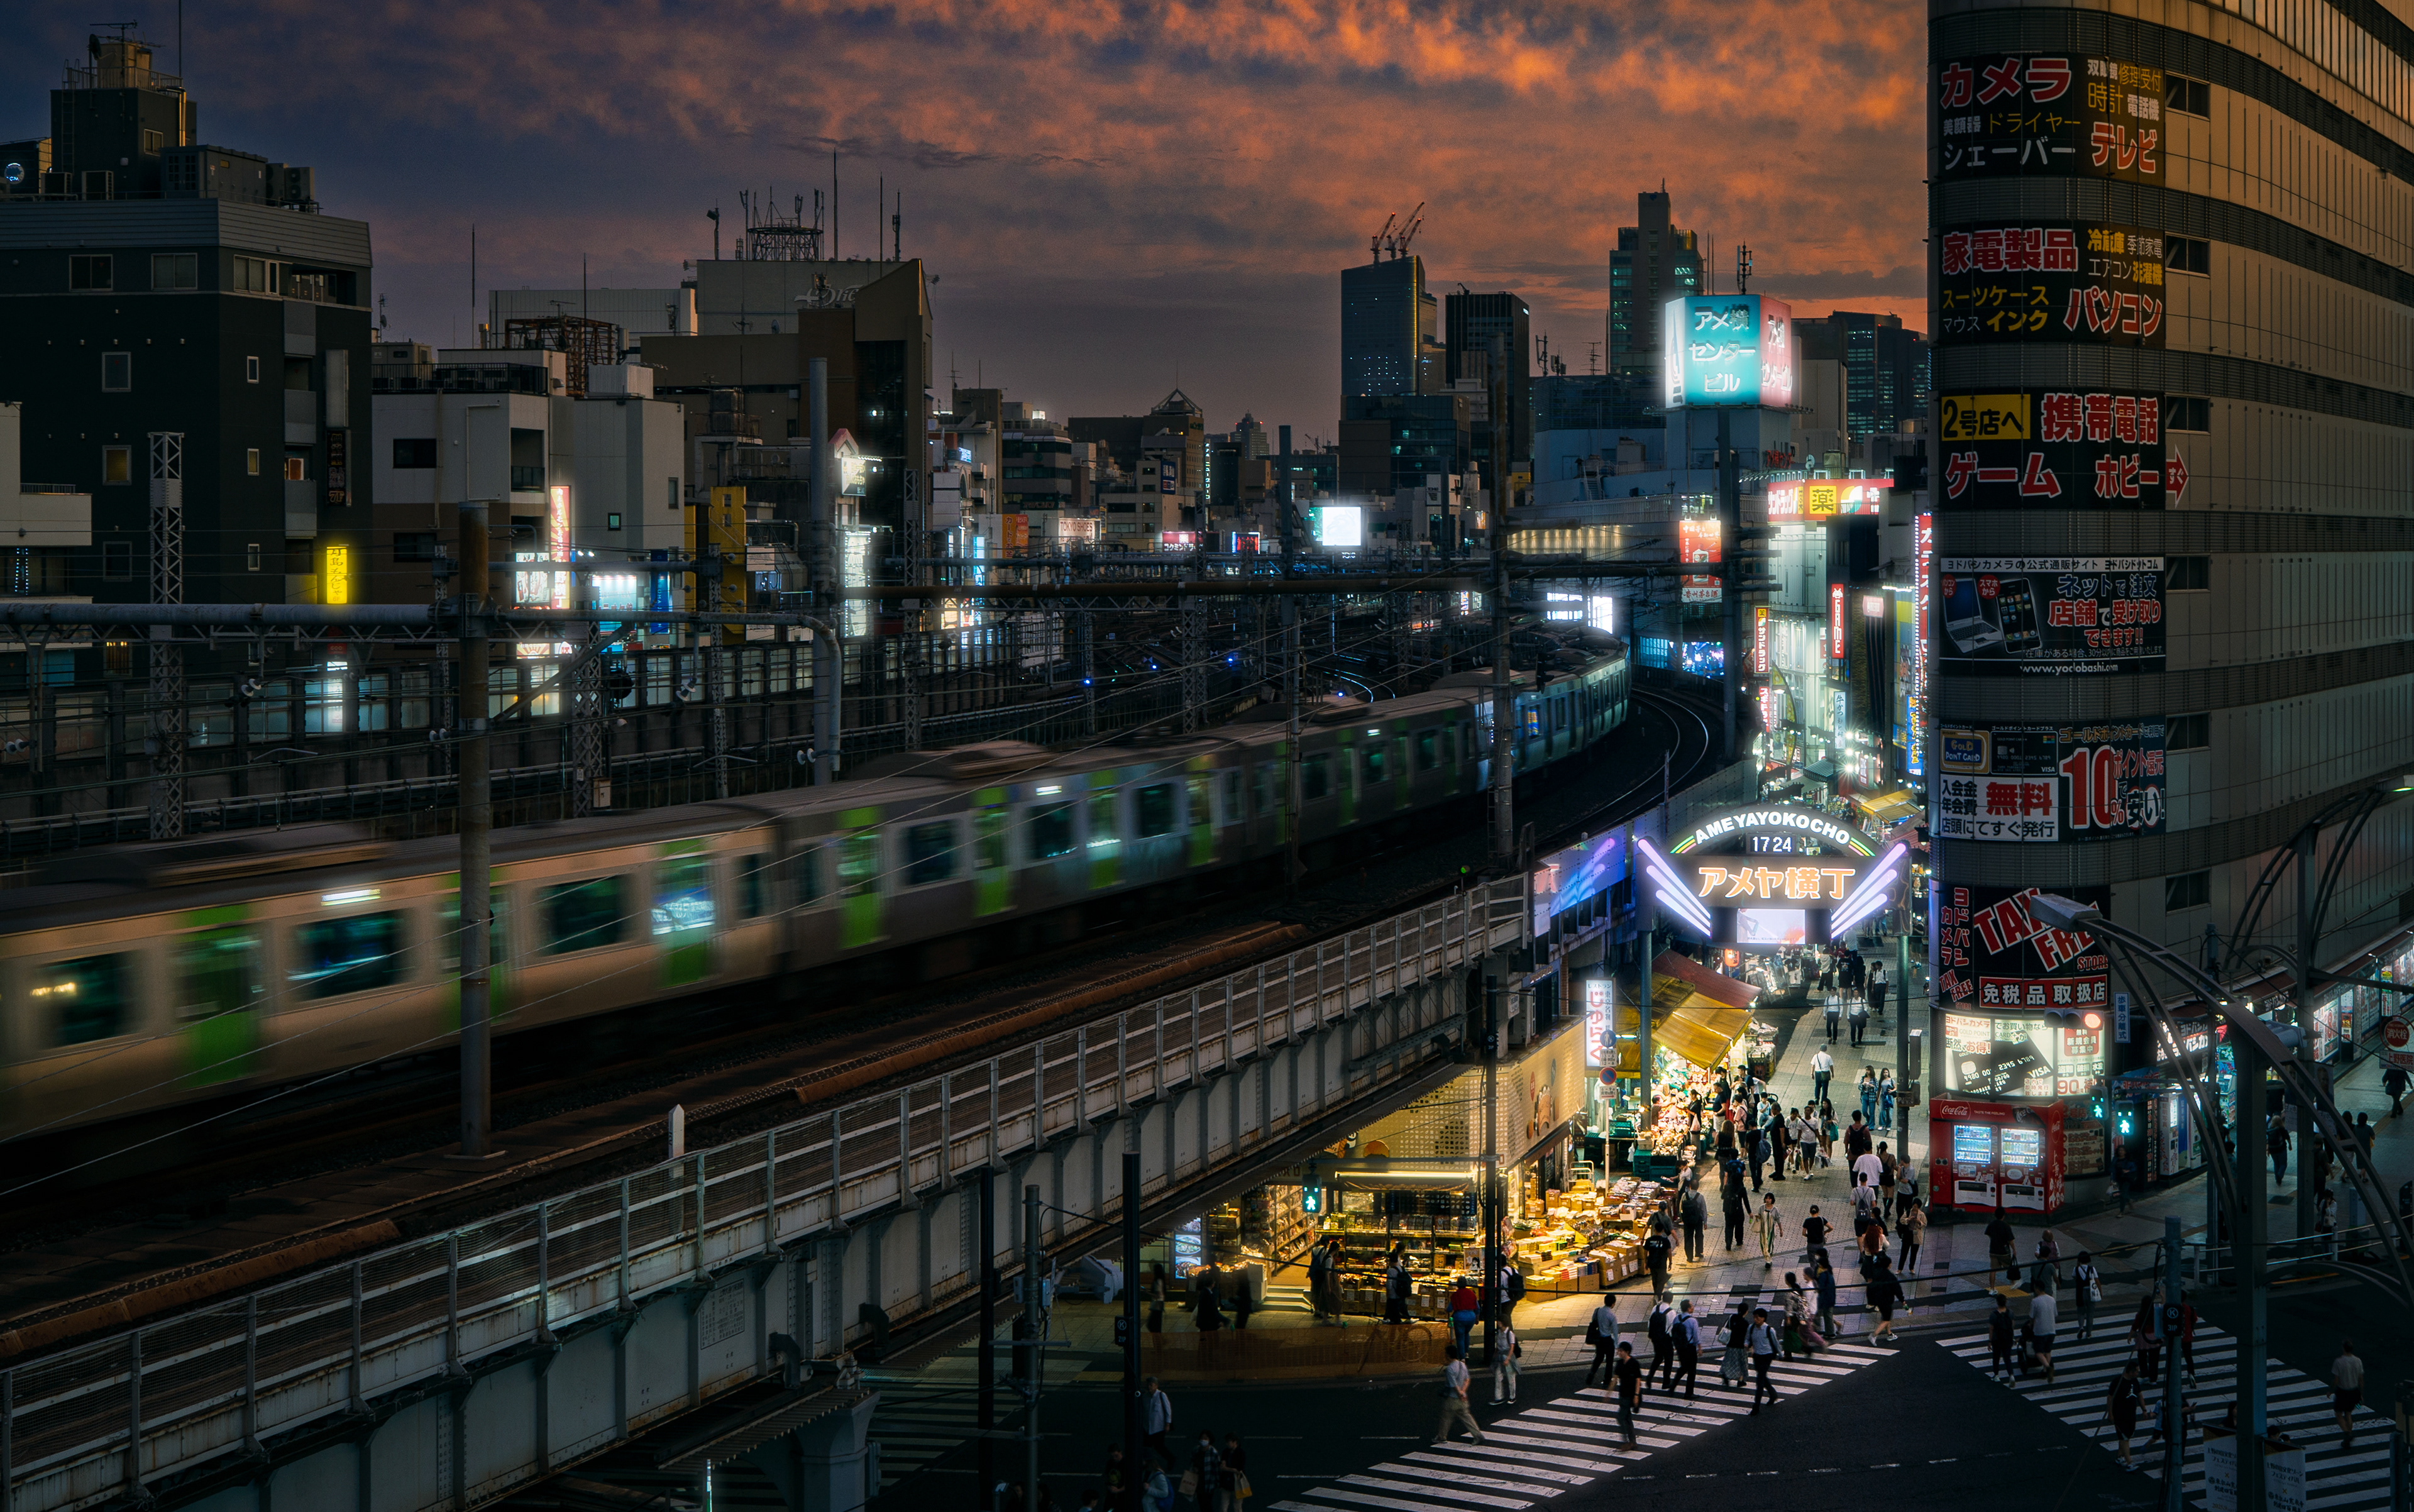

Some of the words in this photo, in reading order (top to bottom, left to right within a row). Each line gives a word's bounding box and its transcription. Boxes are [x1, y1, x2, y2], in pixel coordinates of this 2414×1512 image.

[1941, 58, 2071, 109] カメラ
[2119, 63, 2161, 92] 修理受付
[2088, 82, 2124, 114] 時計
[2127, 94, 2159, 121] 電話機
[1943, 116, 1981, 136] 美顔器
[1990, 112, 2080, 135] ドライヤー
[1944, 135, 2075, 170] シェーバー
[2091, 121, 2157, 174] テレビ
[1943, 227, 2078, 275] 家電製品
[2087, 228, 2124, 254] 冷蔵庫
[2127, 235, 2163, 258] 季節家電
[2088, 258, 2132, 279] エアコン
[2132, 260, 2163, 285] 洗濯機
[1943, 285, 2049, 309] スーツケース
[1694, 308, 1750, 331] アメ横
[1943, 315, 1981, 333] マウス
[1987, 309, 2048, 332] インク
[2063, 285, 2163, 337] パソコン
[1689, 340, 1756, 361] センター
[1704, 373, 1740, 392] ビル
[1943, 399, 2024, 439] 2号店へ
[2041, 393, 2158, 445] 携帯電話
[1946, 451, 2061, 499] ゲーム
[2095, 454, 2159, 499] ホビー
[2168, 466, 2184, 485] すぐ
[1768, 487, 1793, 515] サンドラッグ
[1812, 488, 1834, 511] 薬
[1060, 521, 1076, 531] TOKYO
[1077, 522, 1093, 532] SHOES
[1948, 560, 2098, 570] ヨドバシカメラの公式通販サイト
[2105, 560, 2158, 570] ヨドバシドットコム
[1944, 587, 1953, 595] から
[1980, 579, 1998, 587] スマホ
[1982, 588, 1995, 596] から
[2056, 573, 2157, 597] ネットで注文
[2047, 599, 2161, 627] 店舗で受け取り
[1832, 598, 1843, 655] GAME
[1758, 626, 1766, 671] サンドラッグ
[1945, 751, 1961, 761] POINT
[2114, 748, 2164, 779] ポイント還元
[1941, 780, 1978, 797] 入会金
[1986, 781, 2053, 816] 無料
[1941, 797, 1977, 817] 年会費
[1695, 812, 1851, 845] AMEYAYOKOCHO
[1941, 819, 2056, 838] 店頭にてすぐ発行
[1698, 866, 1856, 900] アメヤ横丁
[1941, 905, 1953, 966] カメラ
[1953, 887, 1970, 967] ヨドバシ
[1939, 969, 1959, 993] TAX
[1949, 979, 1973, 1003] FREE
[1983, 981, 2105, 1006] 免税品取扱店
[1955, 1002, 1971, 1010] STORE
[2117, 995, 2127, 1040] 歩車分離式
[1946, 1016, 1990, 1028] ヨドバシカメラ
[2387, 1028, 2408, 1039] 消火栓
[1998, 1061, 2015, 1071] 2345
[2017, 1055, 2035, 1065] 6789
[2389, 1052, 2414, 1065] 上野医院
[2027, 1066, 2051, 1078] VISA
[1942, 1105, 1969, 1116] Coca-Cola
